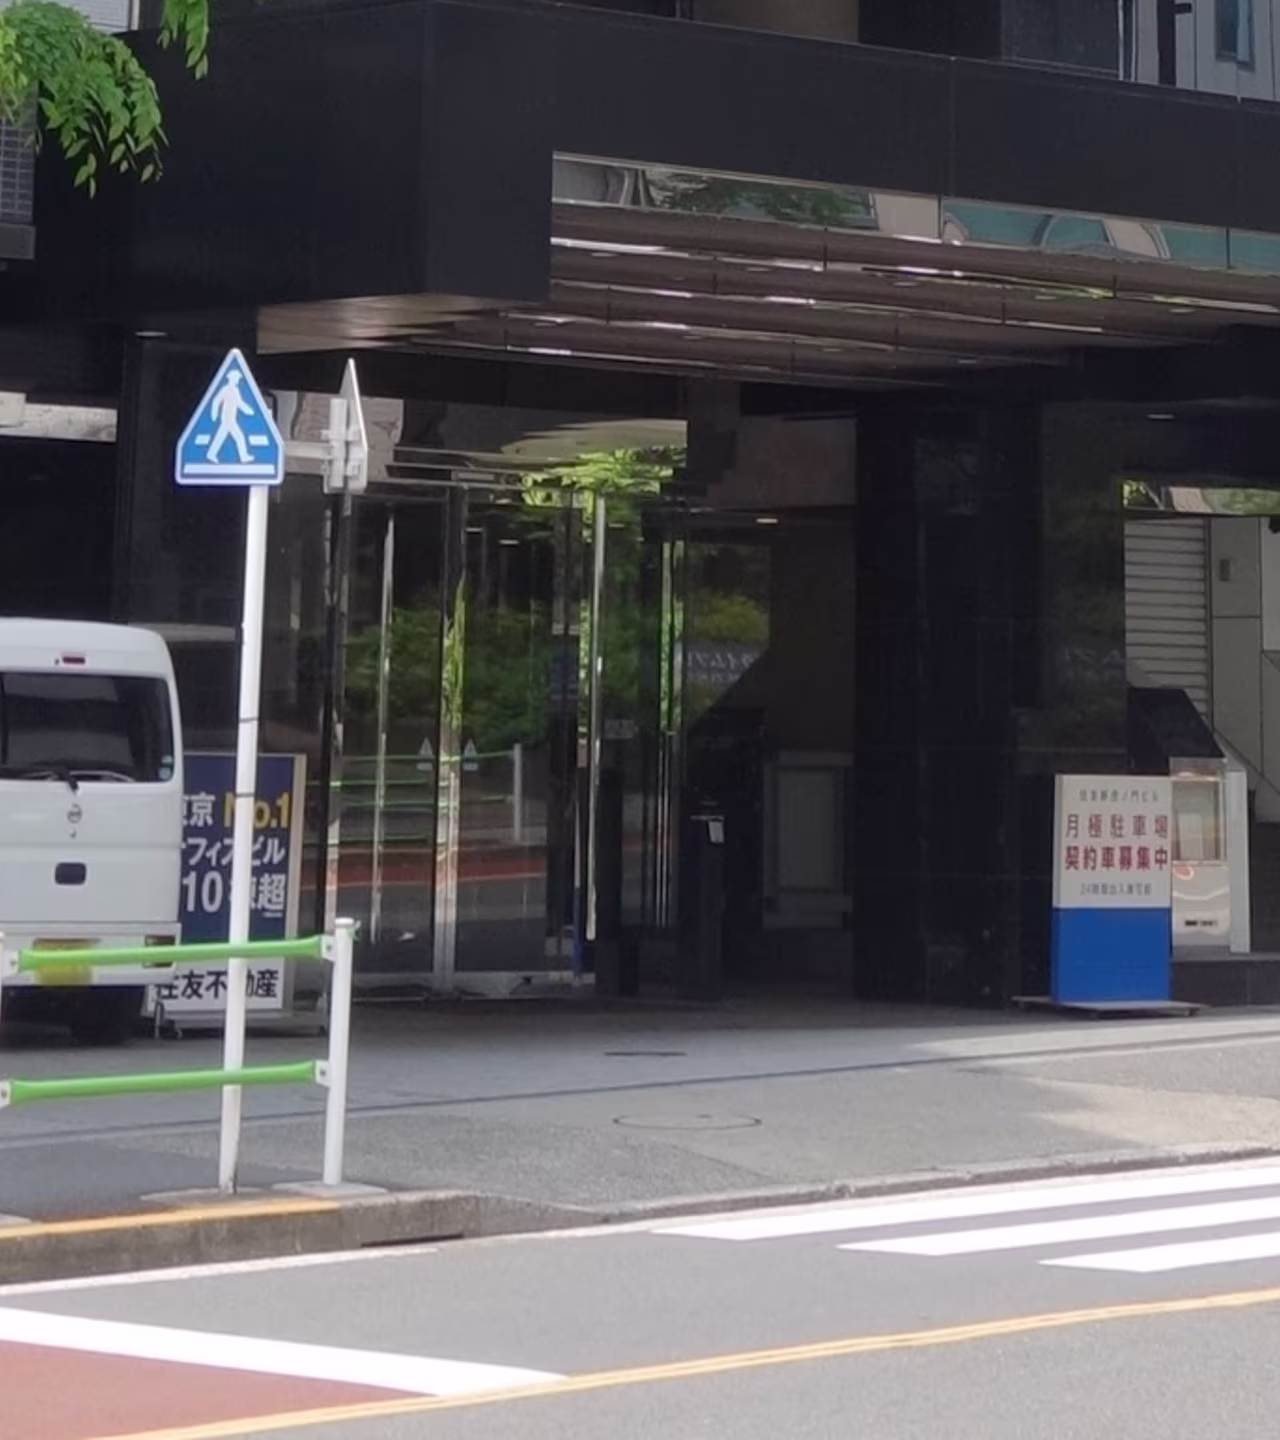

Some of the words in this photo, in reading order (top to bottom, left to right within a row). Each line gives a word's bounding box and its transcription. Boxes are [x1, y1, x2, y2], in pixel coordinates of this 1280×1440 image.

[1065, 813, 1169, 839] 月極駐車場
[181, 835, 286, 867] フィスビル
[1064, 845, 1168, 871] 契約車募集中
